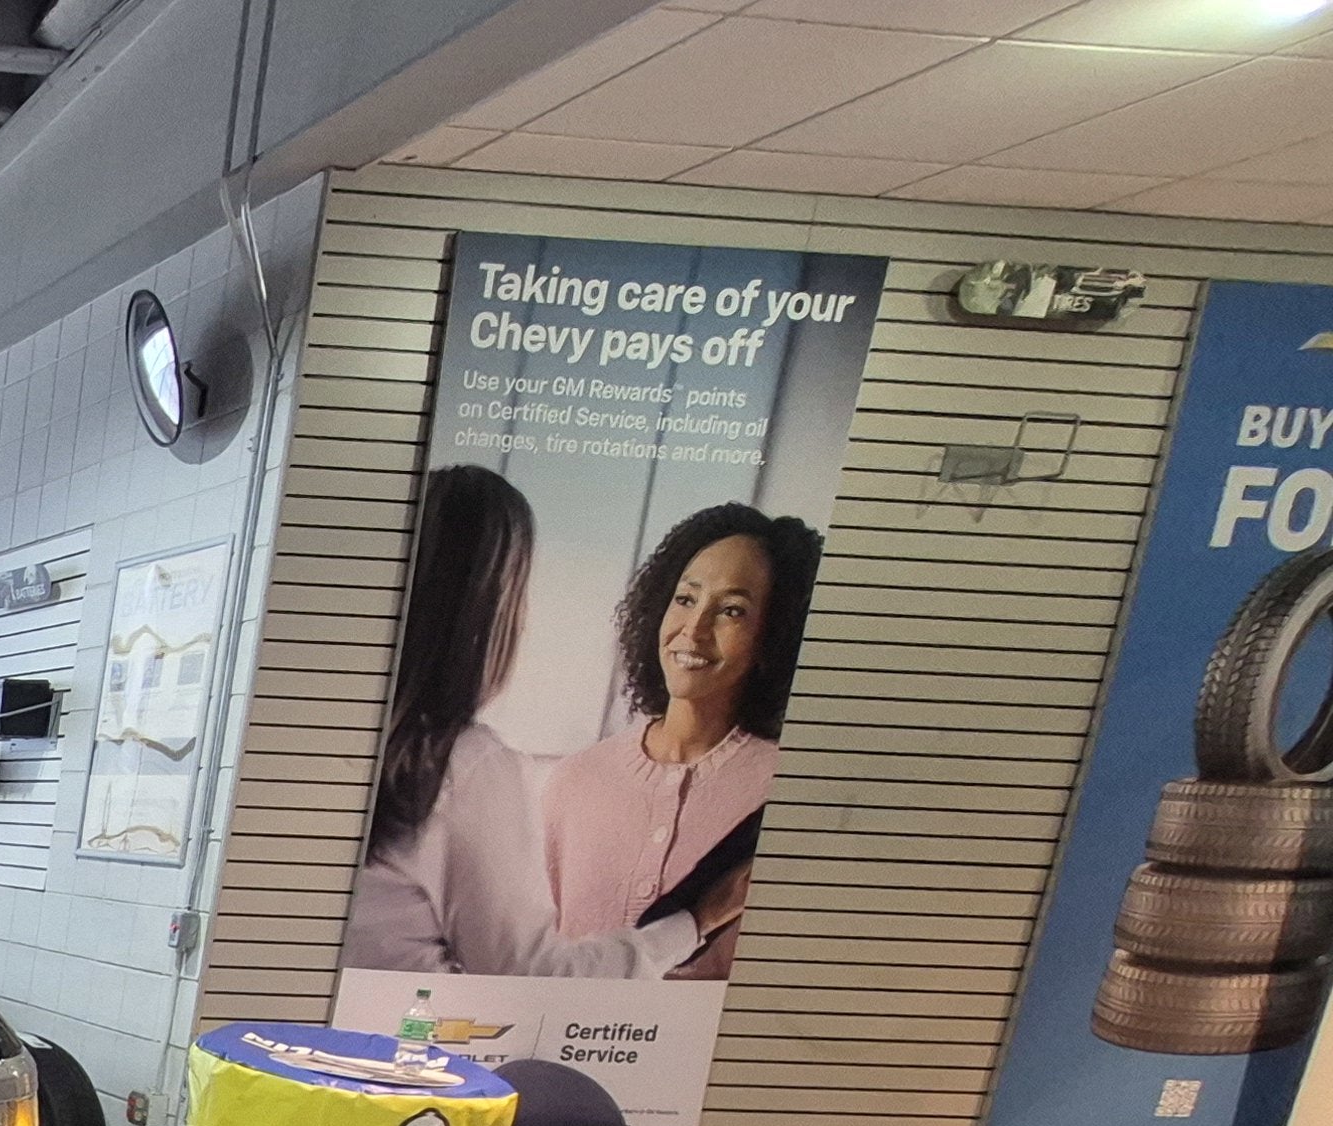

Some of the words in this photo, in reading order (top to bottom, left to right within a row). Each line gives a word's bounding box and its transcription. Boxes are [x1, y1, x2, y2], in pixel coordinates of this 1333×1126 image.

[479, 262, 610, 316] Taking
[618, 281, 707, 315] care
[715, 279, 763, 317] of
[761, 290, 857, 327] your
[1053, 294, 1095, 313] TIRES
[470, 311, 595, 364] Chevy
[599, 329, 694, 369] pays
[701, 328, 766, 367] off
[463, 370, 500, 391] Use
[503, 376, 549, 396] your
[552, 376, 585, 398] GM
[686, 386, 747, 409] points
[459, 402, 482, 418] on
[488, 401, 573, 425] Certified
[575, 406, 649, 433] Service,
[656, 411, 742, 440] including
[745, 418, 769, 437] oil
[1236, 405, 1333, 450] BUY
[454, 427, 539, 454] changes,
[546, 433, 578, 454] tire
[583, 438, 667, 460] rotations
[671, 443, 708, 462] and
[710, 449, 767, 466] more.
[1209, 465, 1333, 552] FO
[564, 1022, 659, 1043] Certified
[559, 1045, 638, 1064] Service
